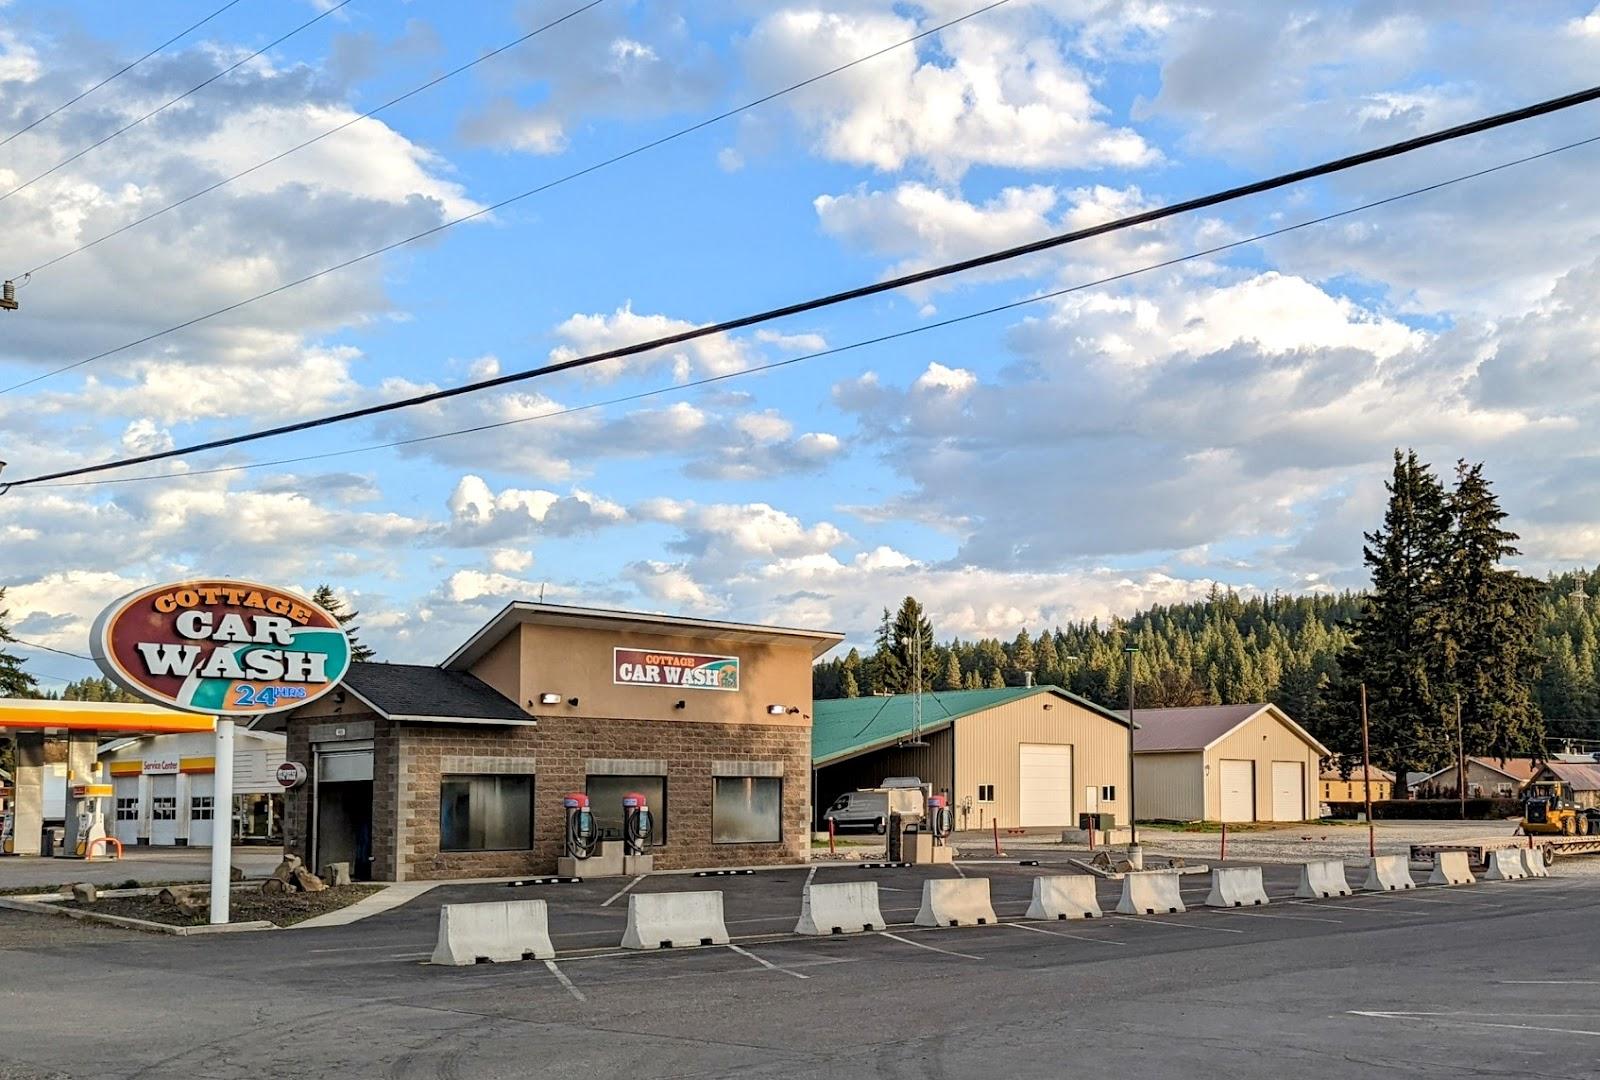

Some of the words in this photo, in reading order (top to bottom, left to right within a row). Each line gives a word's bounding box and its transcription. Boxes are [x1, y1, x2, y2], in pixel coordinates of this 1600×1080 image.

[155, 588, 312, 625] COTTAGE
[175, 610, 295, 645] CAR
[138, 642, 328, 682] WASH
[619, 663, 660, 682] CAR
[664, 666, 719, 685] WASH
[646, 655, 695, 667] COTTAGE
[143, 760, 161, 770] Service
[161, 760, 178, 770] Center
